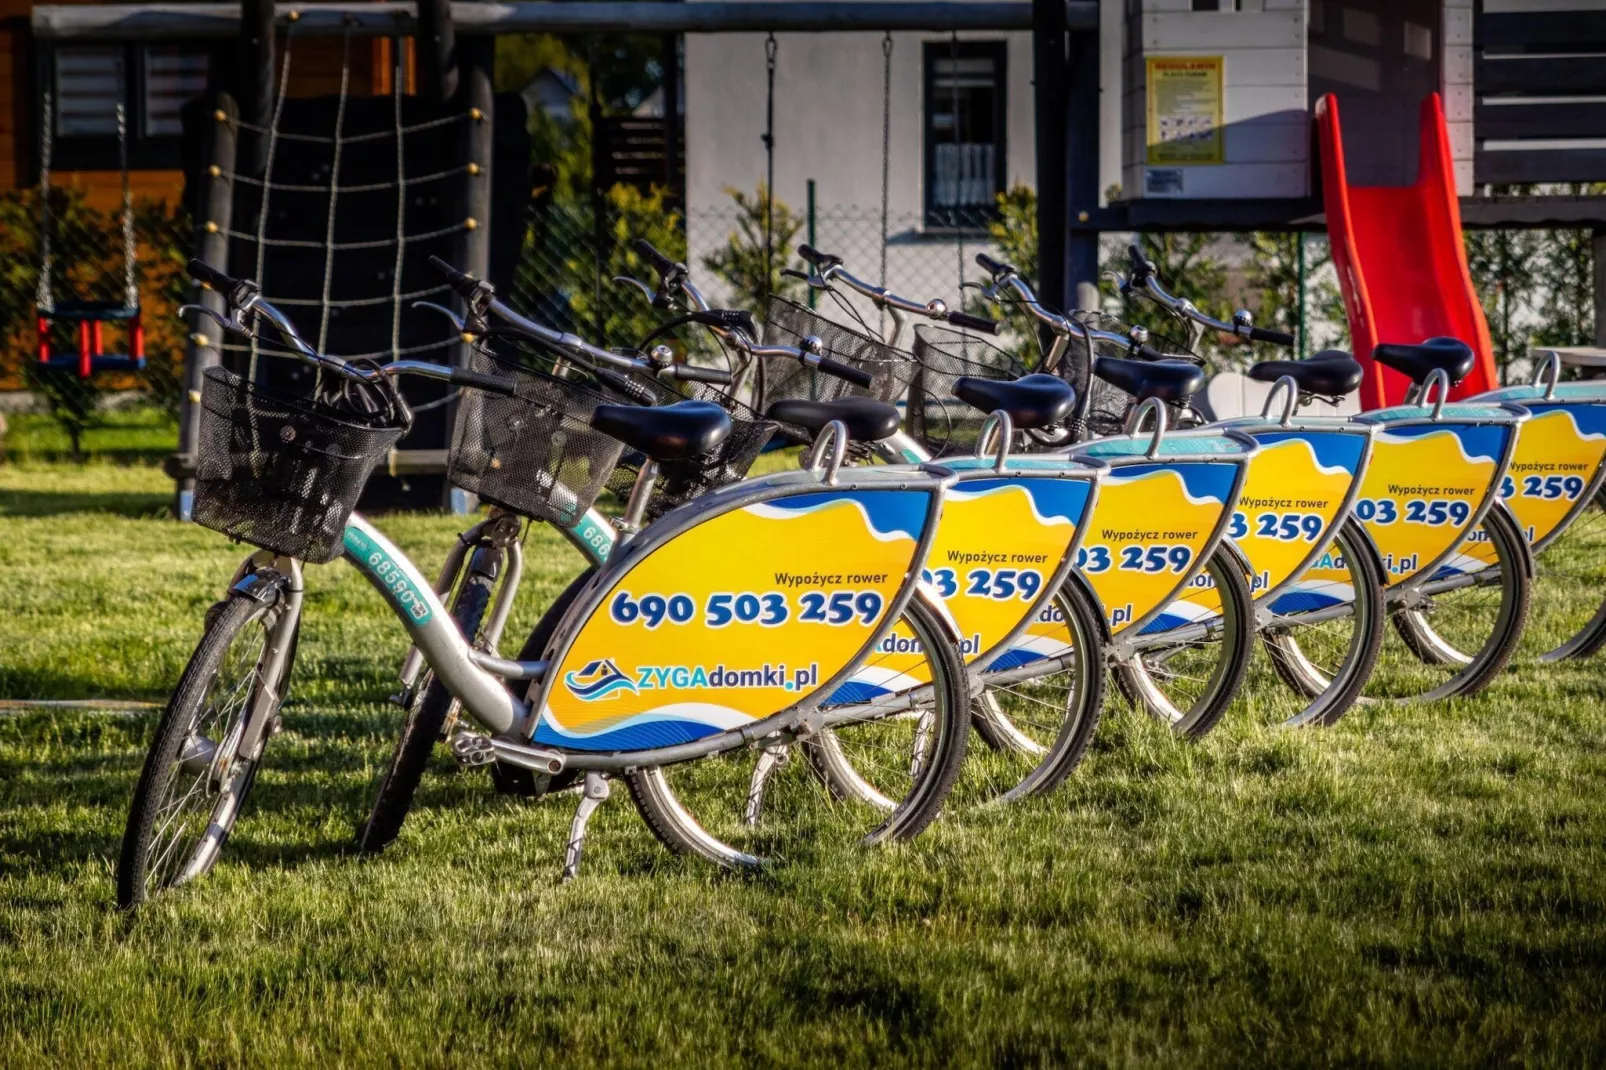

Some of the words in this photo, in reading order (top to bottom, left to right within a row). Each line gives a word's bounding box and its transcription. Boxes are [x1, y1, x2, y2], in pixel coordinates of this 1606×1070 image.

[1558, 463, 1589, 471] rower
[1387, 484, 1440, 496] Wypożycz
[1442, 486, 1476, 495] rower
[1522, 475, 1584, 500] 259
[1239, 496, 1292, 509] Wypożycz
[1295, 499, 1329, 508] rower
[1355, 498, 1398, 524] 03
[1405, 499, 1470, 526] 259
[1101, 529, 1159, 542] Wypożycz
[1162, 530, 1198, 540] rower
[1256, 513, 1323, 541] 259
[947, 550, 1007, 564] Wypożycz
[1010, 553, 1048, 563] rower
[1119, 545, 1192, 573] 259
[368, 552, 415, 603] 68590
[774, 571, 842, 588] Wypożycz
[846, 573, 888, 584] rower
[966, 568, 1042, 601] 259
[610, 591, 695, 629] 690
[705, 592, 789, 626] 503
[799, 591, 883, 625] 259
[636, 663, 818, 692] ZYGAdomki.pl
